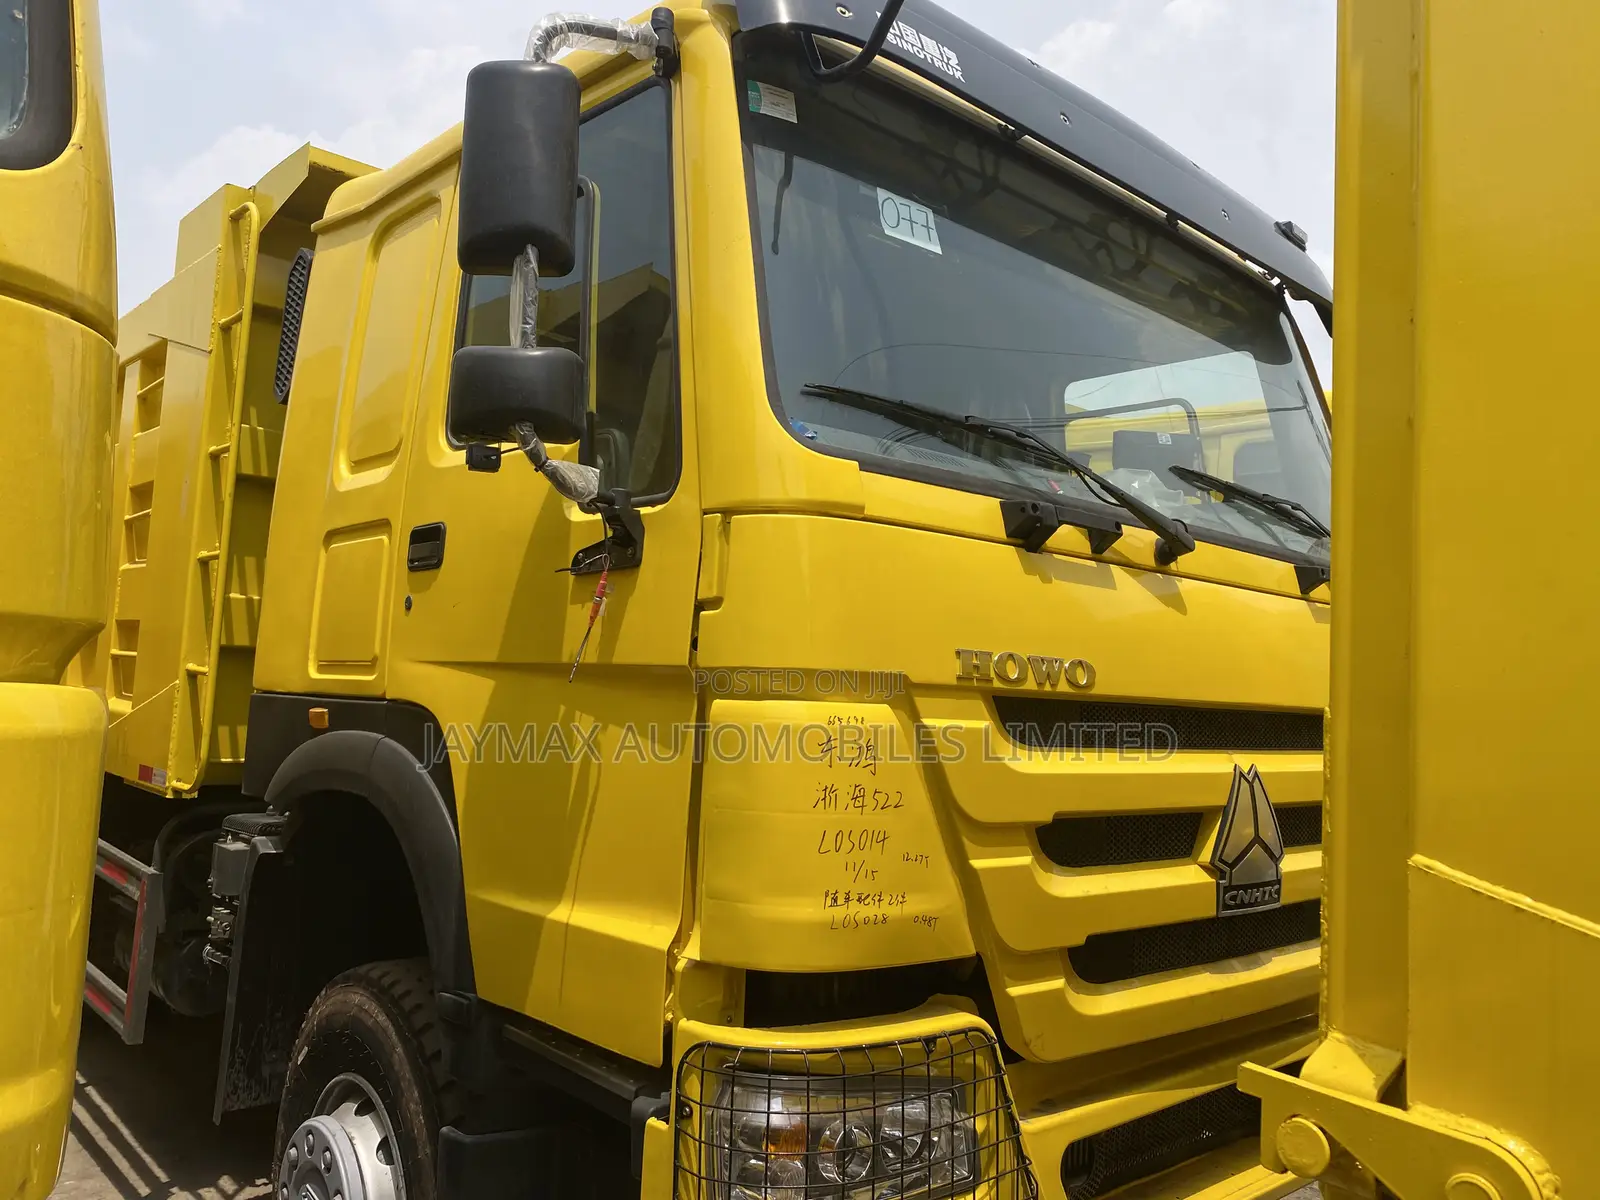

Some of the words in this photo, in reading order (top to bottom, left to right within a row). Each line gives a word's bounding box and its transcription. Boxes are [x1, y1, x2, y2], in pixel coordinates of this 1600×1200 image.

[886, 32, 966, 83] SINOTRUK
[881, 196, 934, 242] 077
[955, 647, 1096, 689] HOWO
[844, 859, 879, 884] 11/15
[1223, 884, 1280, 906] CNHTC
